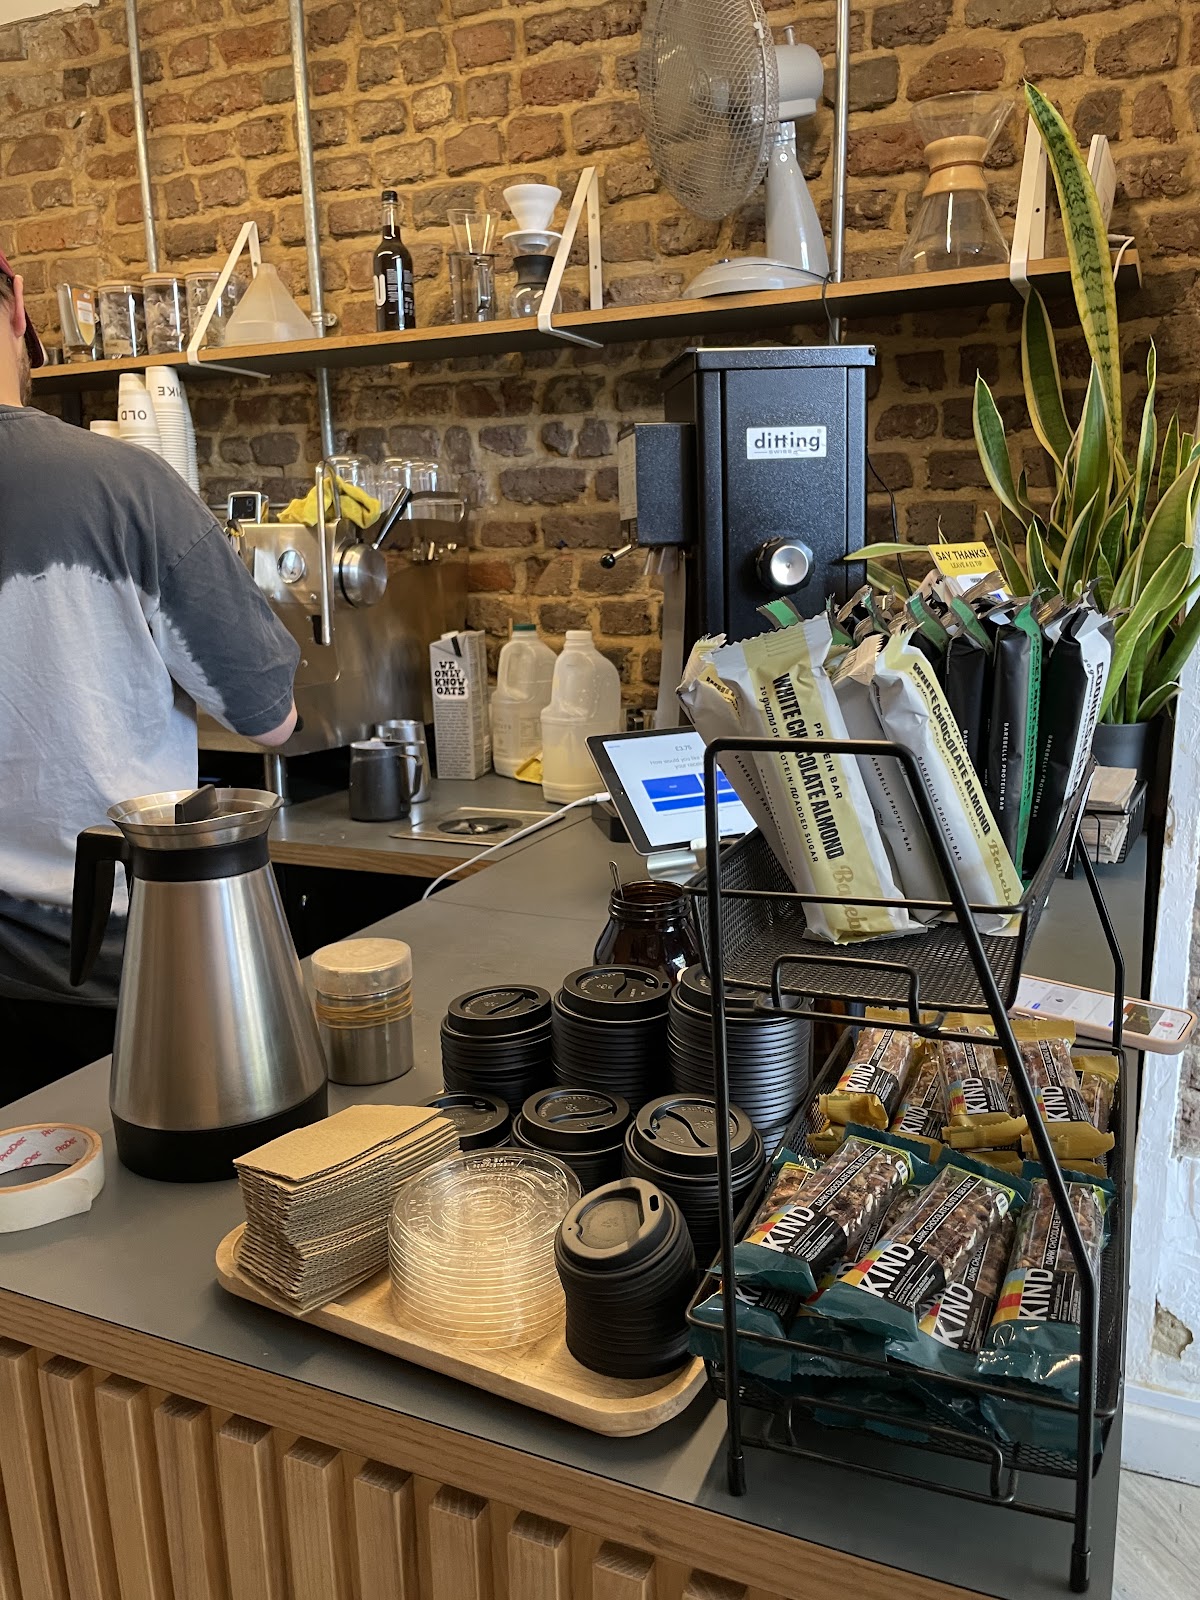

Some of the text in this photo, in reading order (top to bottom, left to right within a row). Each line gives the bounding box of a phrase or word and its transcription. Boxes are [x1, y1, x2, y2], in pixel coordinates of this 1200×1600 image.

[158, 386, 182, 397] IKE
[754, 431, 820, 452] ditting
[936, 548, 990, 561] SAY THANKS!
[434, 670, 461, 678] ONLY
[439, 661, 455, 670] WE
[434, 678, 466, 686] KNOW
[436, 686, 466, 696] OATS
[760, 686, 766, 695] 20
[759, 697, 776, 726] grams
[912, 662, 991, 838] WHITE CHOCOLATE ALMOND
[1001, 722, 1009, 763] BAREBELLS
[734, 755, 761, 795] BAREBELLS
[772, 672, 845, 860] WHITE CHCOLATE ALMOND
[814, 722, 843, 800] PREIN BAR
[790, 786, 799, 800] no
[1037, 772, 1046, 804] PROTEIN
[793, 800, 808, 831] ADDED
[871, 757, 912, 852] AREBELLS PROTEIN BAR
[804, 832, 819, 863] SUGAR
[936, 806, 954, 842] PROTEIN
[952, 846, 962, 861] BAR
[845, 1063, 876, 1093] KIND
[962, 1078, 989, 1115] KIND
[1040, 1086, 1071, 1122] KIND
[900, 1106, 929, 1135] KIND
[0, 1136, 27, 1161] ProDec
[20, 1151, 42, 1167] oDec
[54, 1137, 78, 1153] ProDec
[814, 1192, 829, 1207] DARK
[825, 1172, 850, 1196] CHOCOLATE
[760, 1206, 815, 1253] KIND
[913, 1228, 928, 1244] DARK
[924, 1203, 950, 1231] CHOCOLATE
[956, 1184, 968, 1196] SEA
[1045, 1219, 1061, 1264] DARK CHOCOLATE
[856, 1243, 915, 1298] KIND
[965, 1265, 979, 1281] DARK
[1017, 1268, 1054, 1321] KIND
[932, 1282, 974, 1349] KIND
